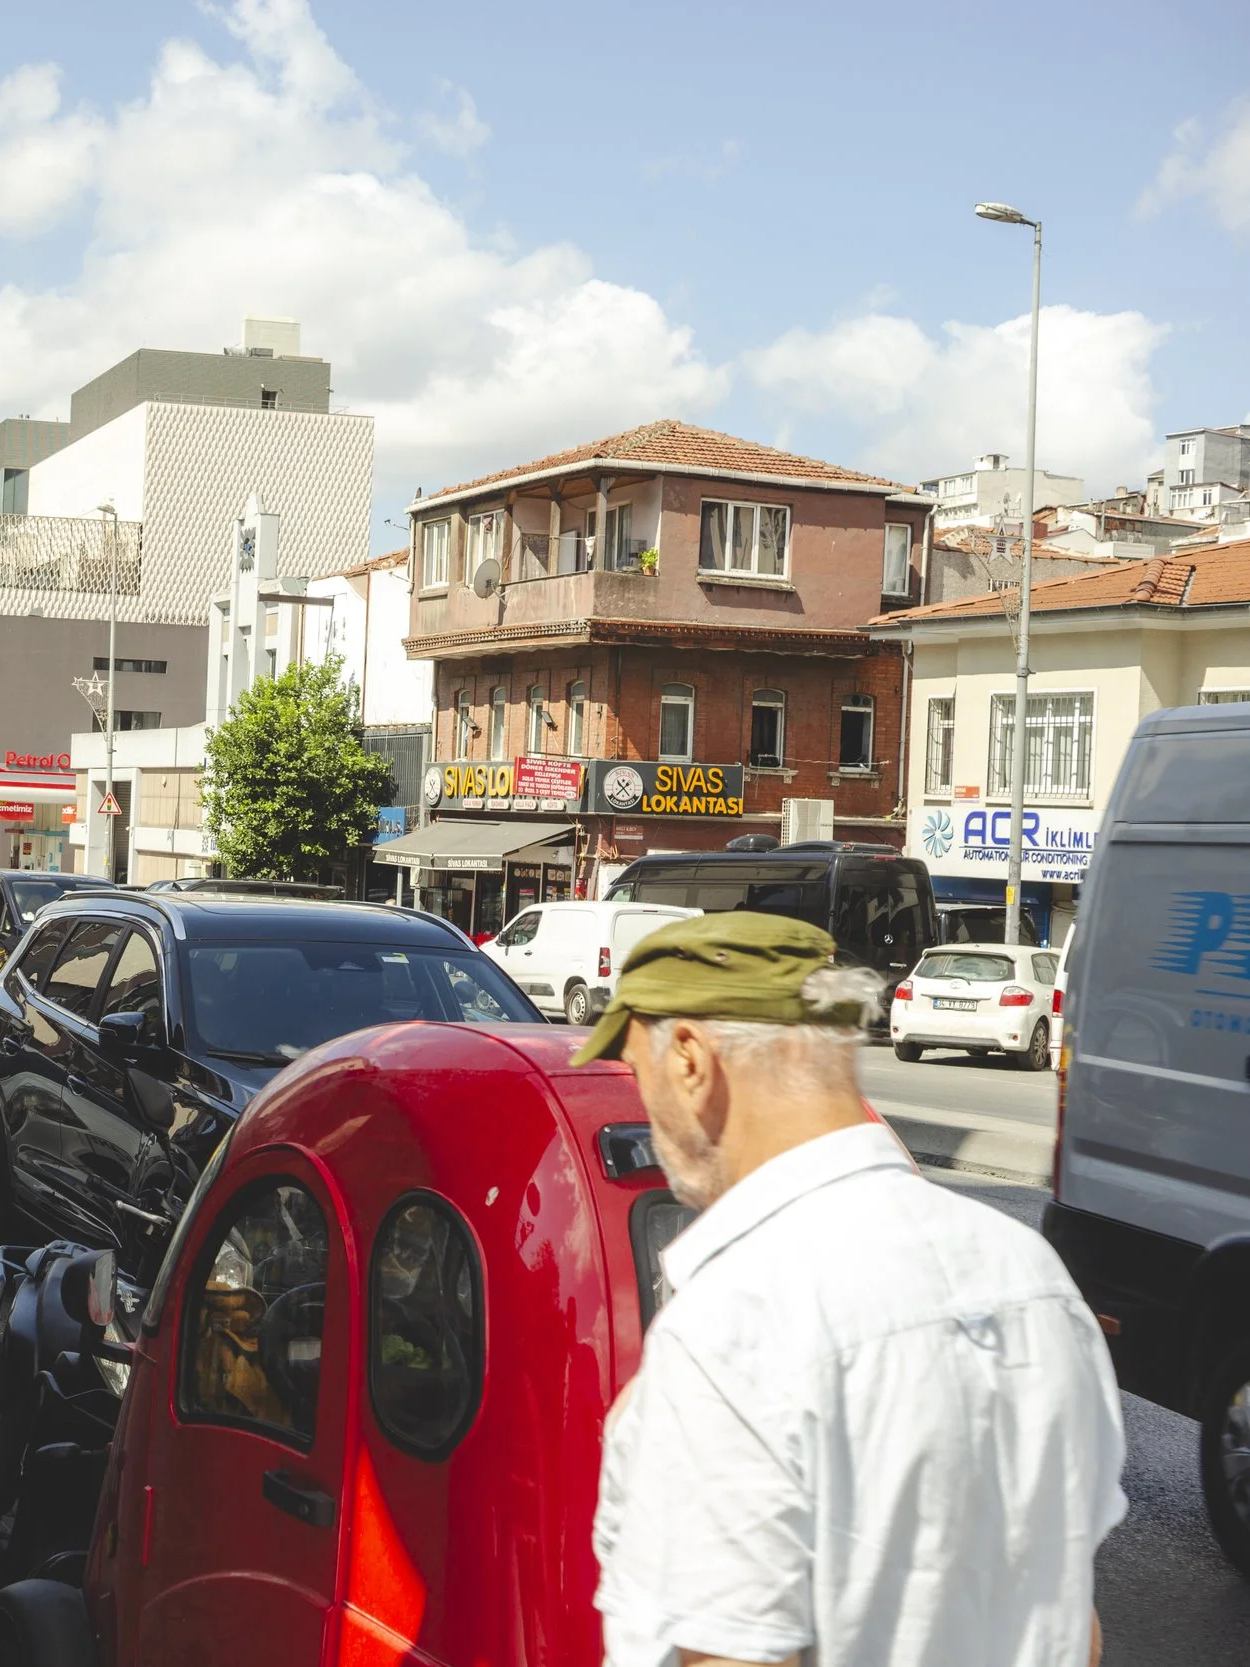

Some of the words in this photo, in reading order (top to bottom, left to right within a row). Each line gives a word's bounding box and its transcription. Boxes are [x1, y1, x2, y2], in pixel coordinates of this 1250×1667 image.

[5, 751, 54, 769] Petrol
[655, 765, 724, 794] SIVAS
[642, 795, 743, 815] LOKANTASI
[963, 810, 1040, 847] ACR
[461, 859, 488, 868] LOKANTASI
[1031, 853, 1088, 866] CONDITIONING
